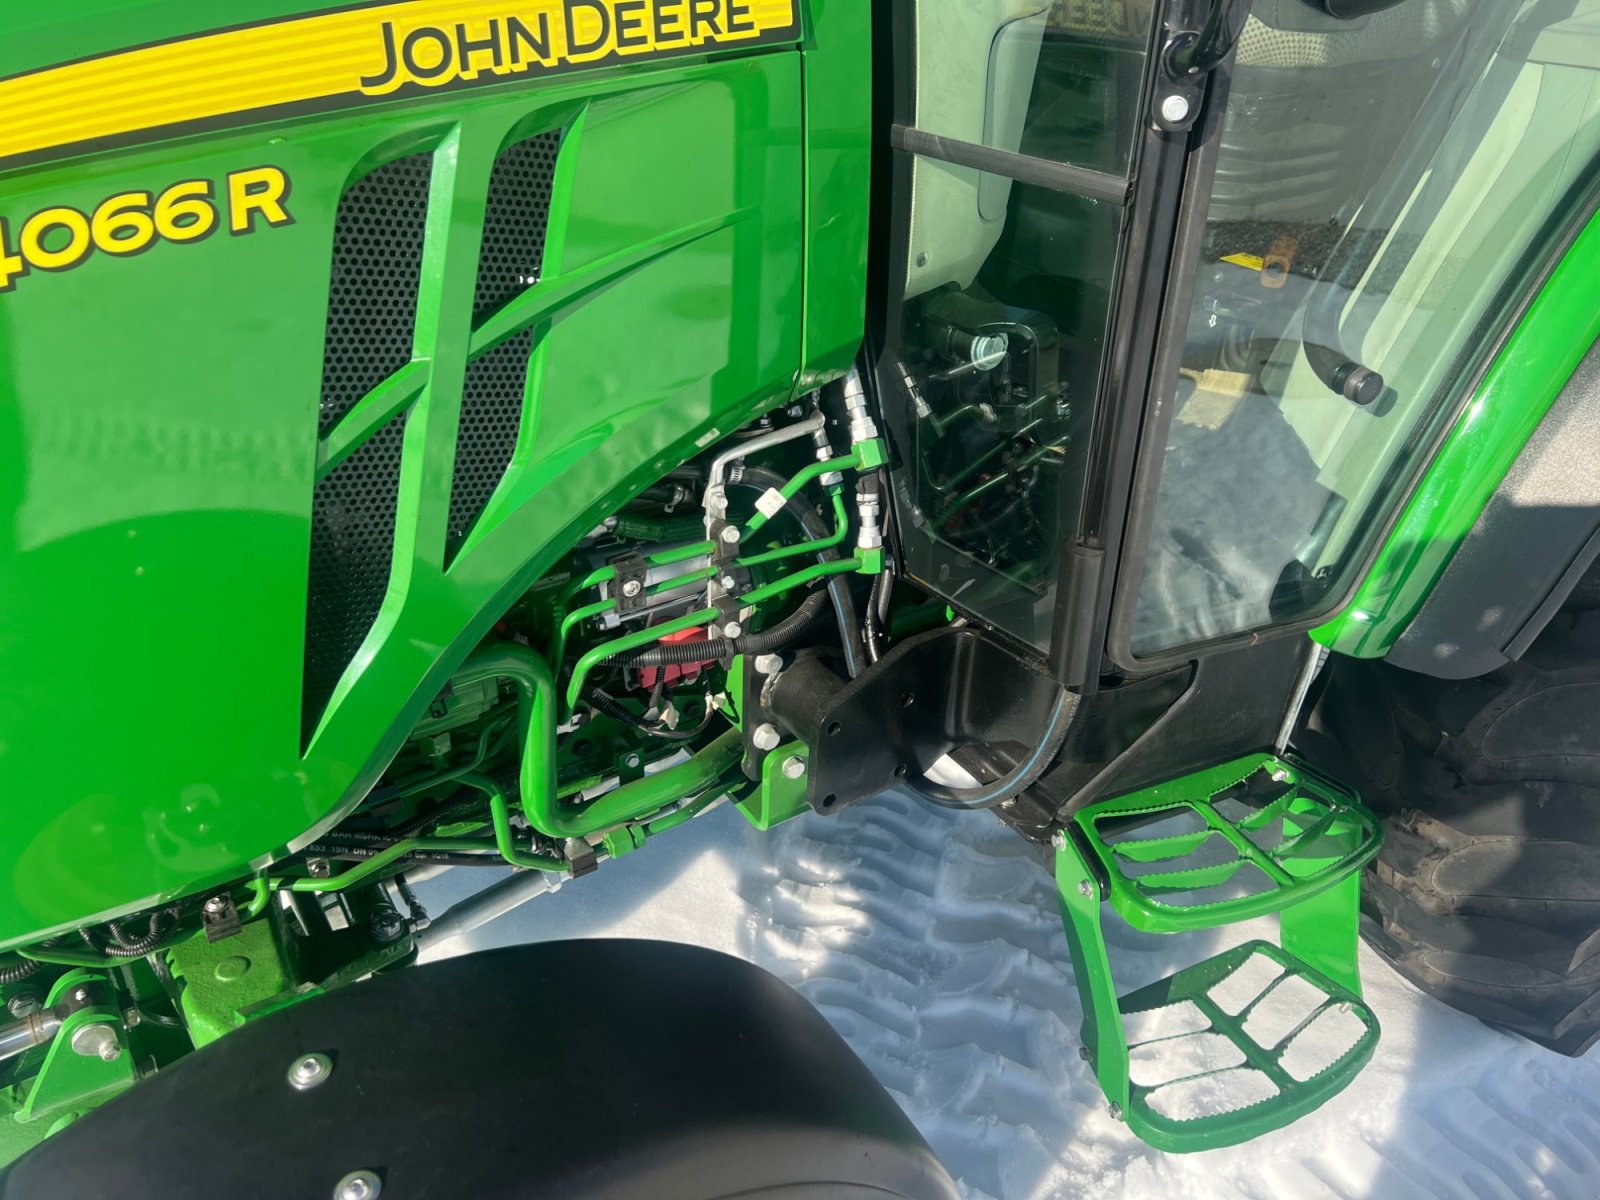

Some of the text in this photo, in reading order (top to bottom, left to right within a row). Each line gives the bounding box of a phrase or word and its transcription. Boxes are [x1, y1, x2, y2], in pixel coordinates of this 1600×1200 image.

[360, 0, 758, 93] JOHN DEERE
[227, 166, 292, 235] R
